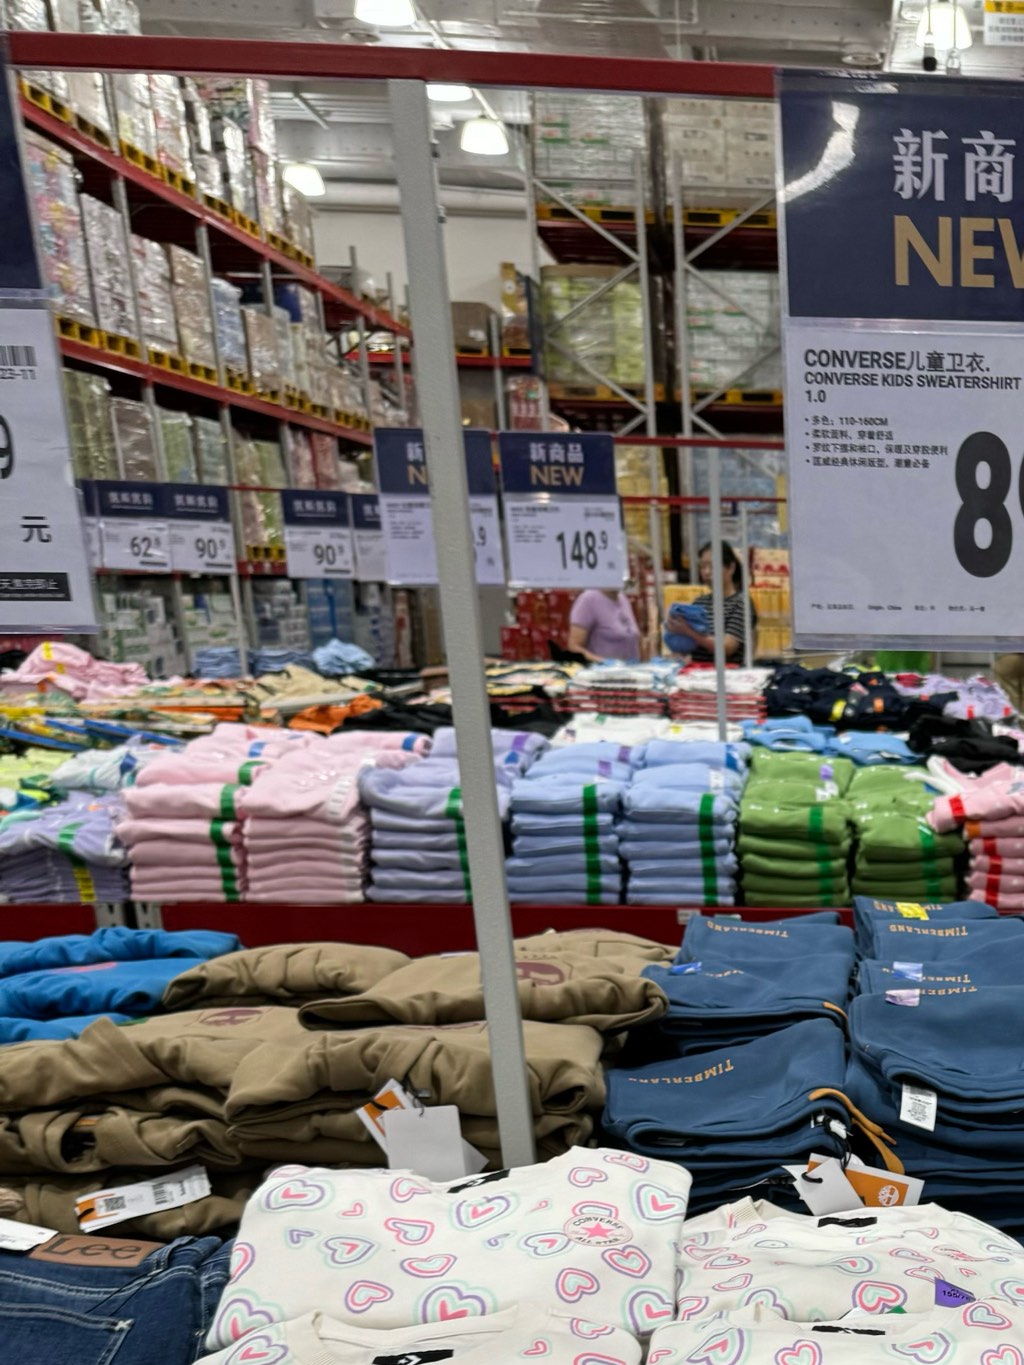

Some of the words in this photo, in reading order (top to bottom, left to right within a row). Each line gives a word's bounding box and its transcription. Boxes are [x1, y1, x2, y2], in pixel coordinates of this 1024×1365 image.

[804, 371, 879, 388] CONVERSE
[882, 372, 914, 388] KIDS
[917, 374, 1022, 391] SWEATERSHIRT
[805, 389, 827, 404] 1.0
[530, 442, 584, 463] 新商品
[530, 465, 584, 486] NEW
[20, 515, 52, 543] 元
[888, 923, 969, 937] TIMBERLAND
[44, 1237, 142, 1260] Lee
